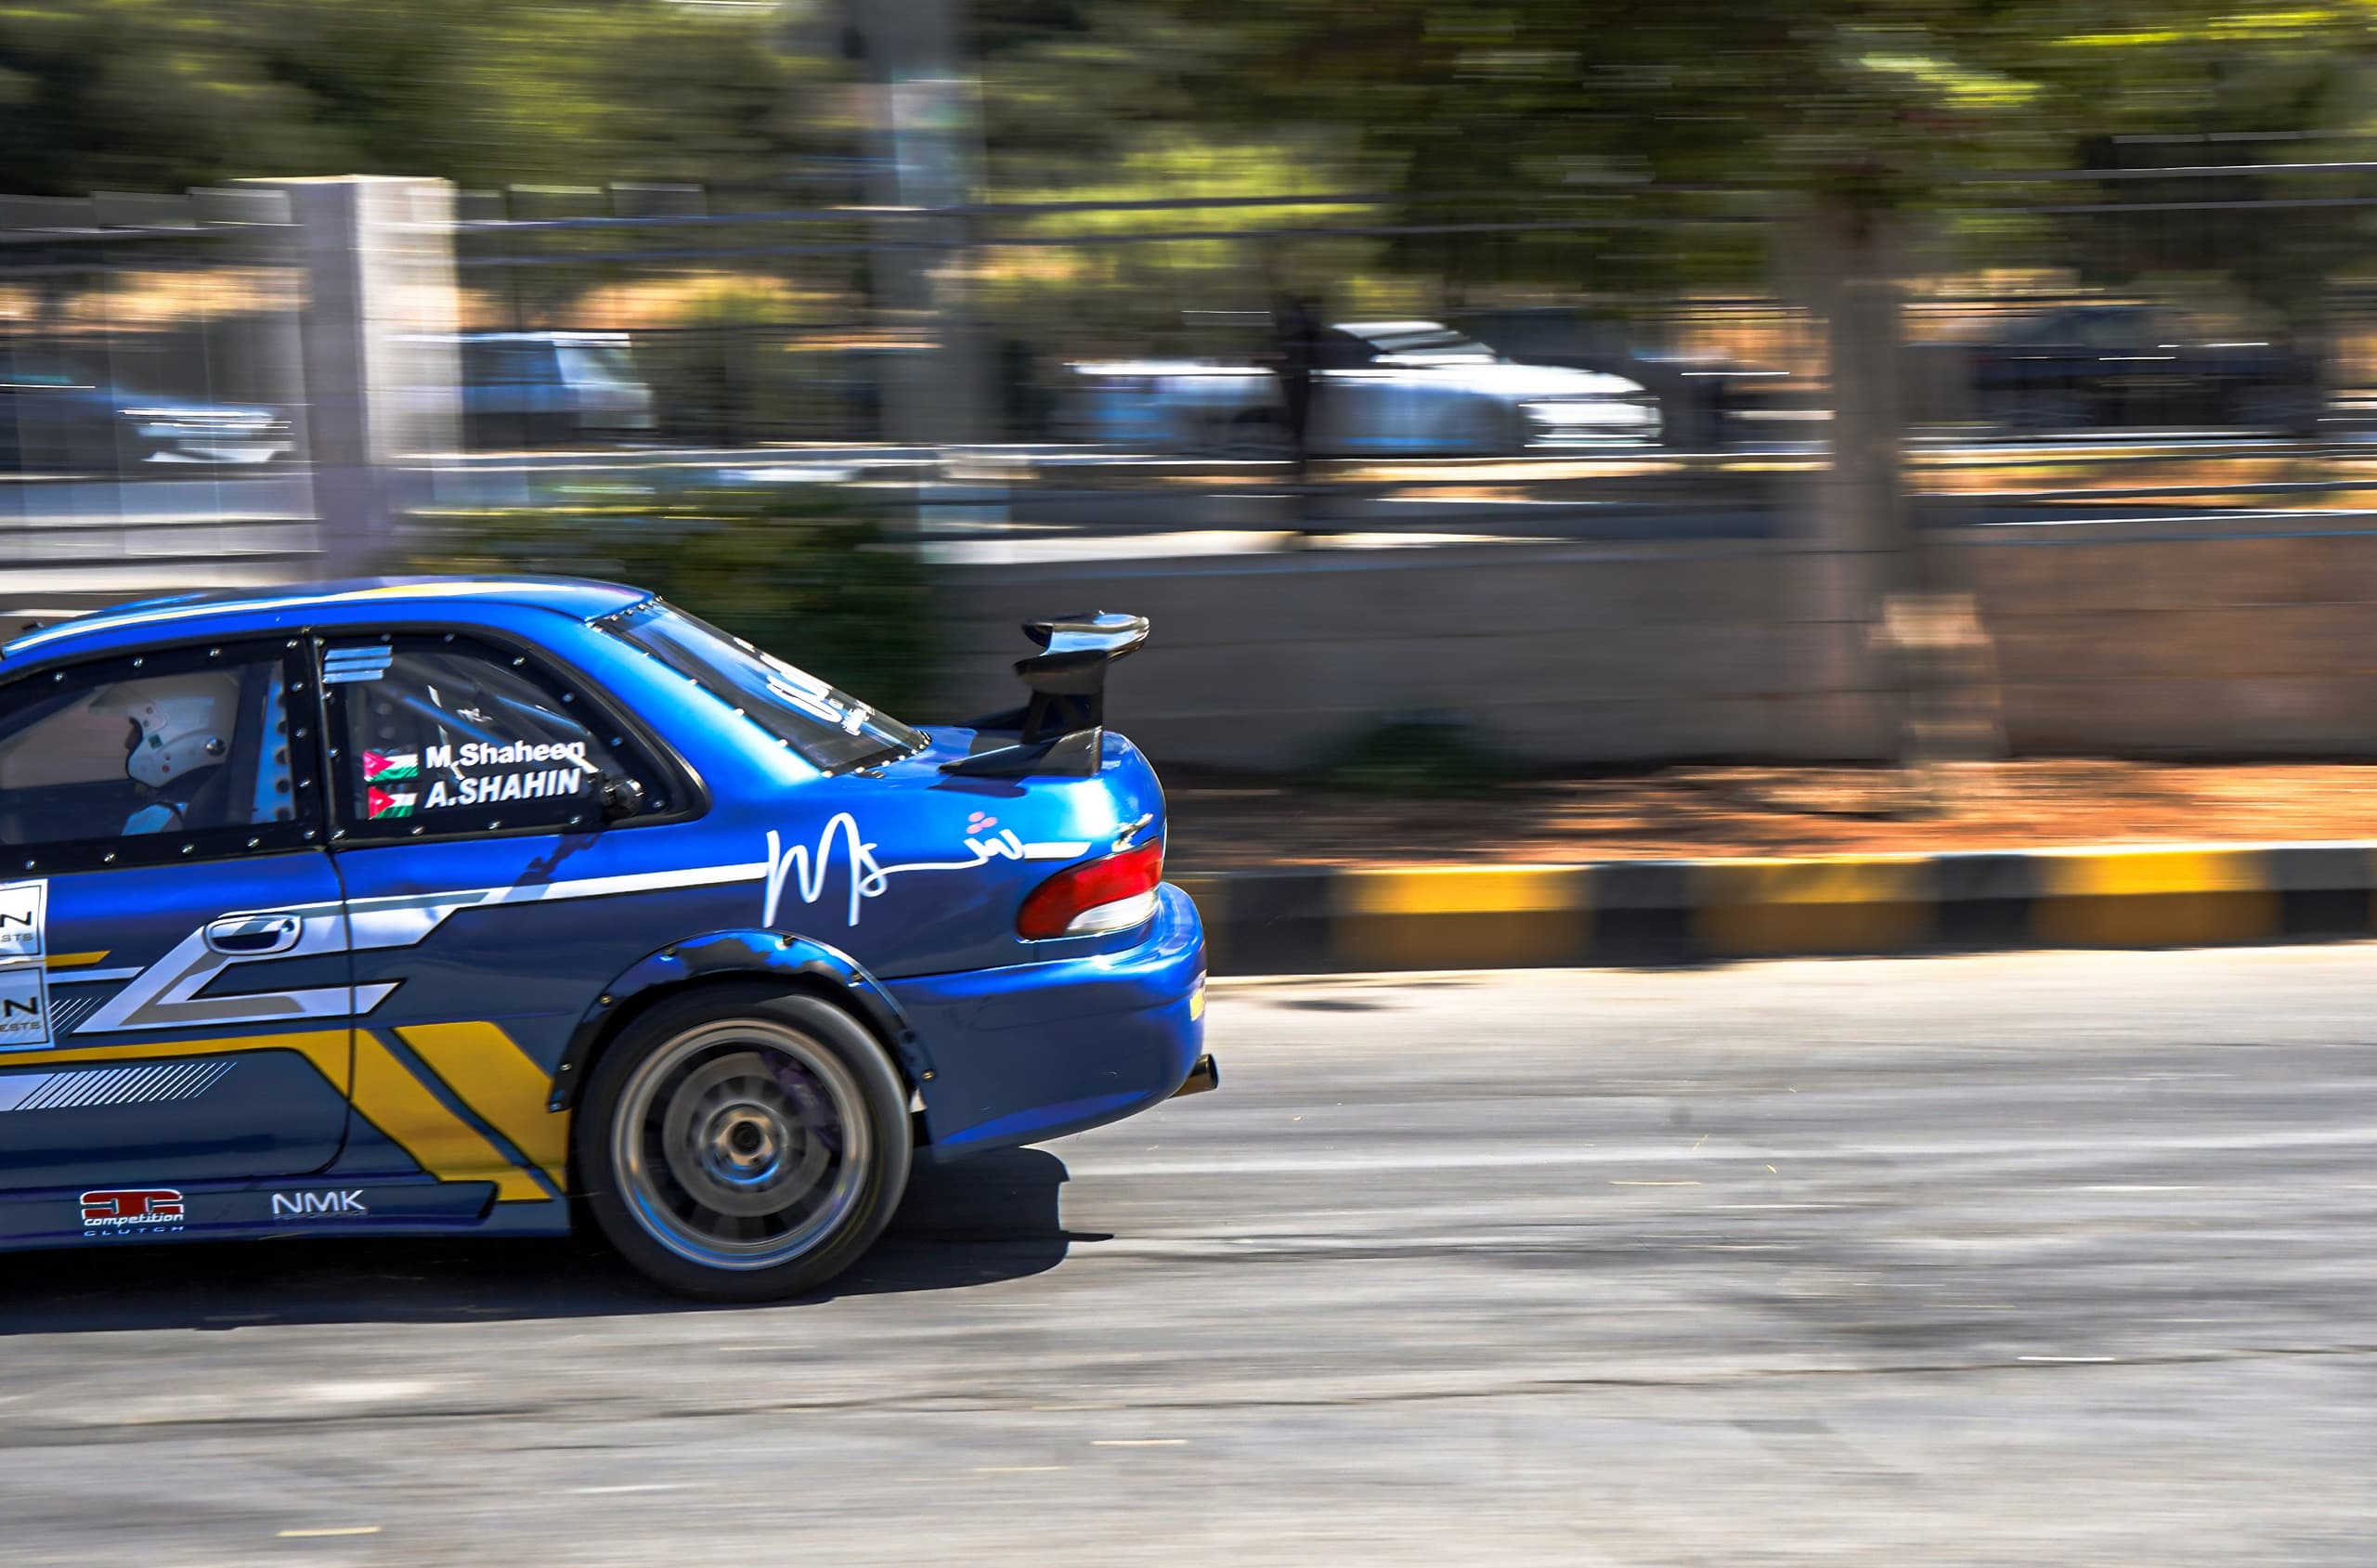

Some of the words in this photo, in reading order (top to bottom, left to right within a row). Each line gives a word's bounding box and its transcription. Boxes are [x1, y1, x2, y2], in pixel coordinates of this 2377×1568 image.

[423, 767, 582, 810] A.SHAHIN
[272, 1189, 366, 1214] NMK
[84, 1212, 185, 1227] competition
[84, 1225, 184, 1237] CLUTCH
